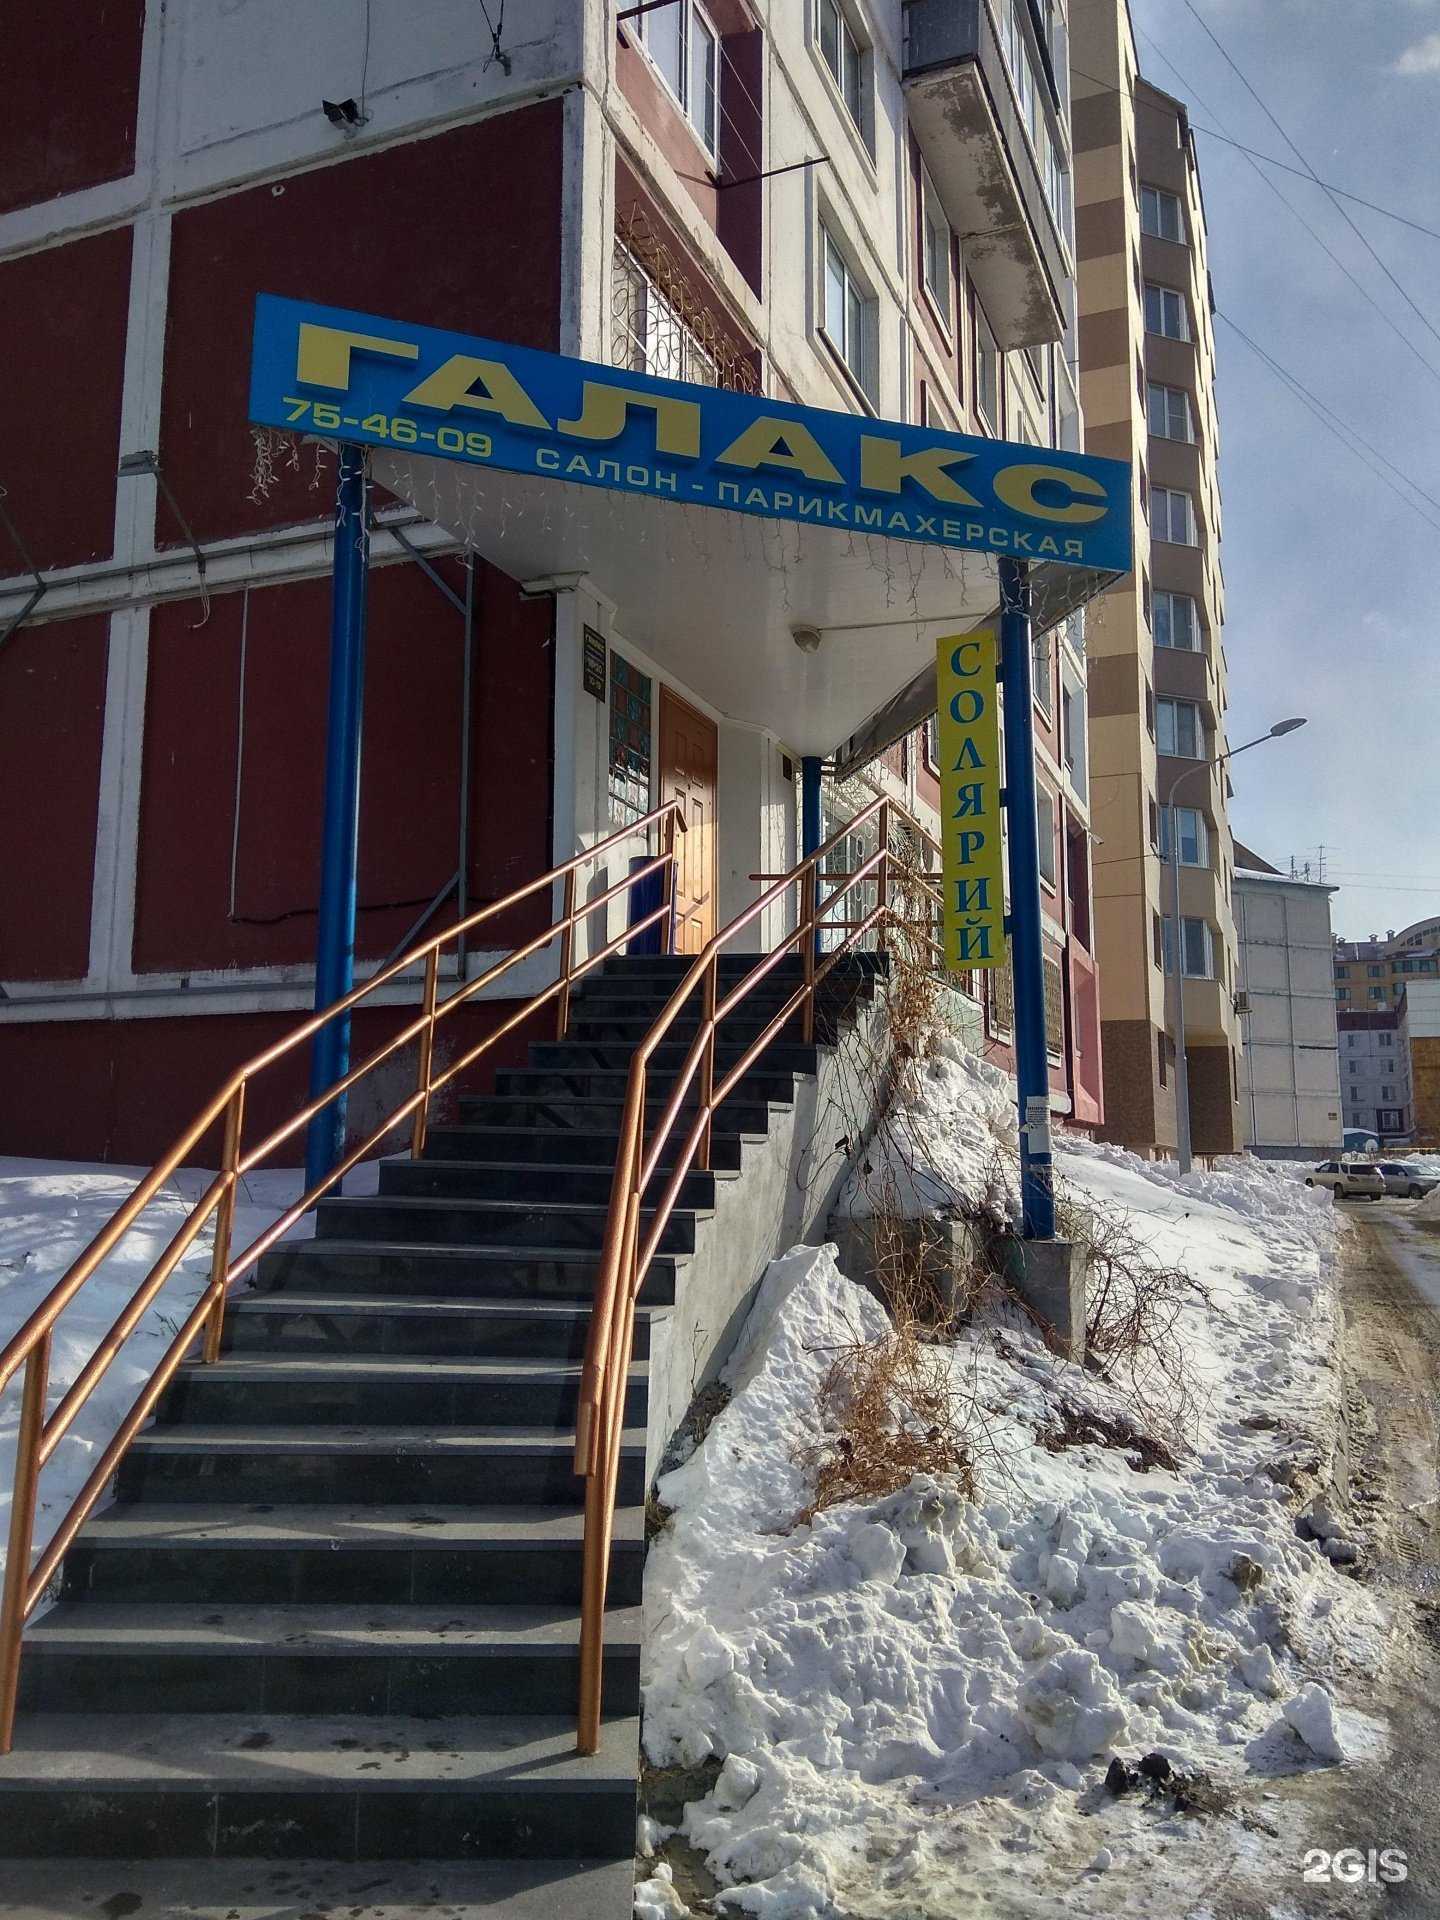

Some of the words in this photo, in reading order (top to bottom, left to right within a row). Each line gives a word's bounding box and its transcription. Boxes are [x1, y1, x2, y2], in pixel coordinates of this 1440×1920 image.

[282, 396, 493, 459] 75-46-09
[296, 322, 1110, 524] ГАЛАКС
[535, 448, 677, 493] САЛОН
[718, 481, 1085, 560] ПАРИКМАХЕРСКАЯ
[949, 642, 995, 961] СОЛЯРИЙ
